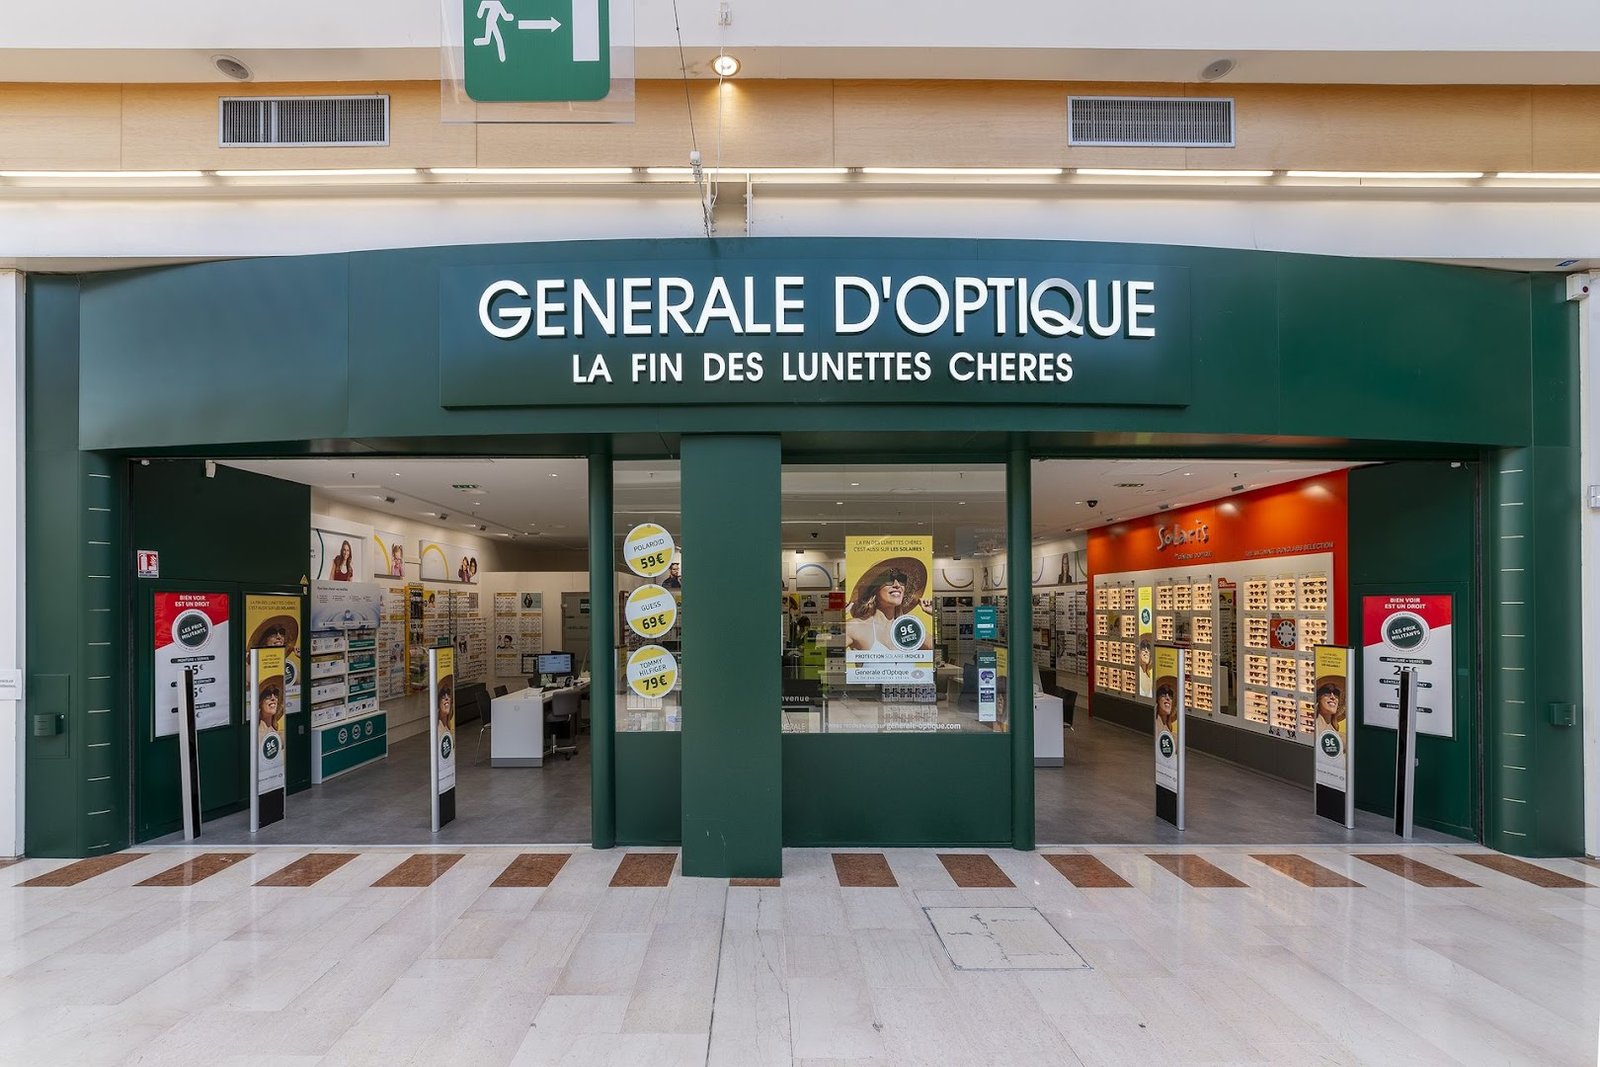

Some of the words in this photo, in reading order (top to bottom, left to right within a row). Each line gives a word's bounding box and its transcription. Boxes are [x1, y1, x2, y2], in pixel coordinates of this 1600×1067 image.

[478, 275, 805, 339] GENERALE
[835, 274, 1156, 339] D'OPTIQUE
[572, 352, 612, 384] LA
[632, 352, 684, 383] FIN
[704, 351, 764, 383] DES
[783, 350, 932, 383] LUNETTES
[948, 350, 1074, 383] CHERES
[1157, 519, 1209, 551] Solaris
[633, 538, 665, 552] POLAROID
[640, 553, 665, 569] 59€
[641, 601, 662, 611] GUESS
[642, 614, 667, 630] 69€
[900, 624, 915, 636] 9€
[638, 664, 667, 677] HILFIGER
[640, 657, 663, 669] TOMMY
[642, 674, 667, 690] 79€
